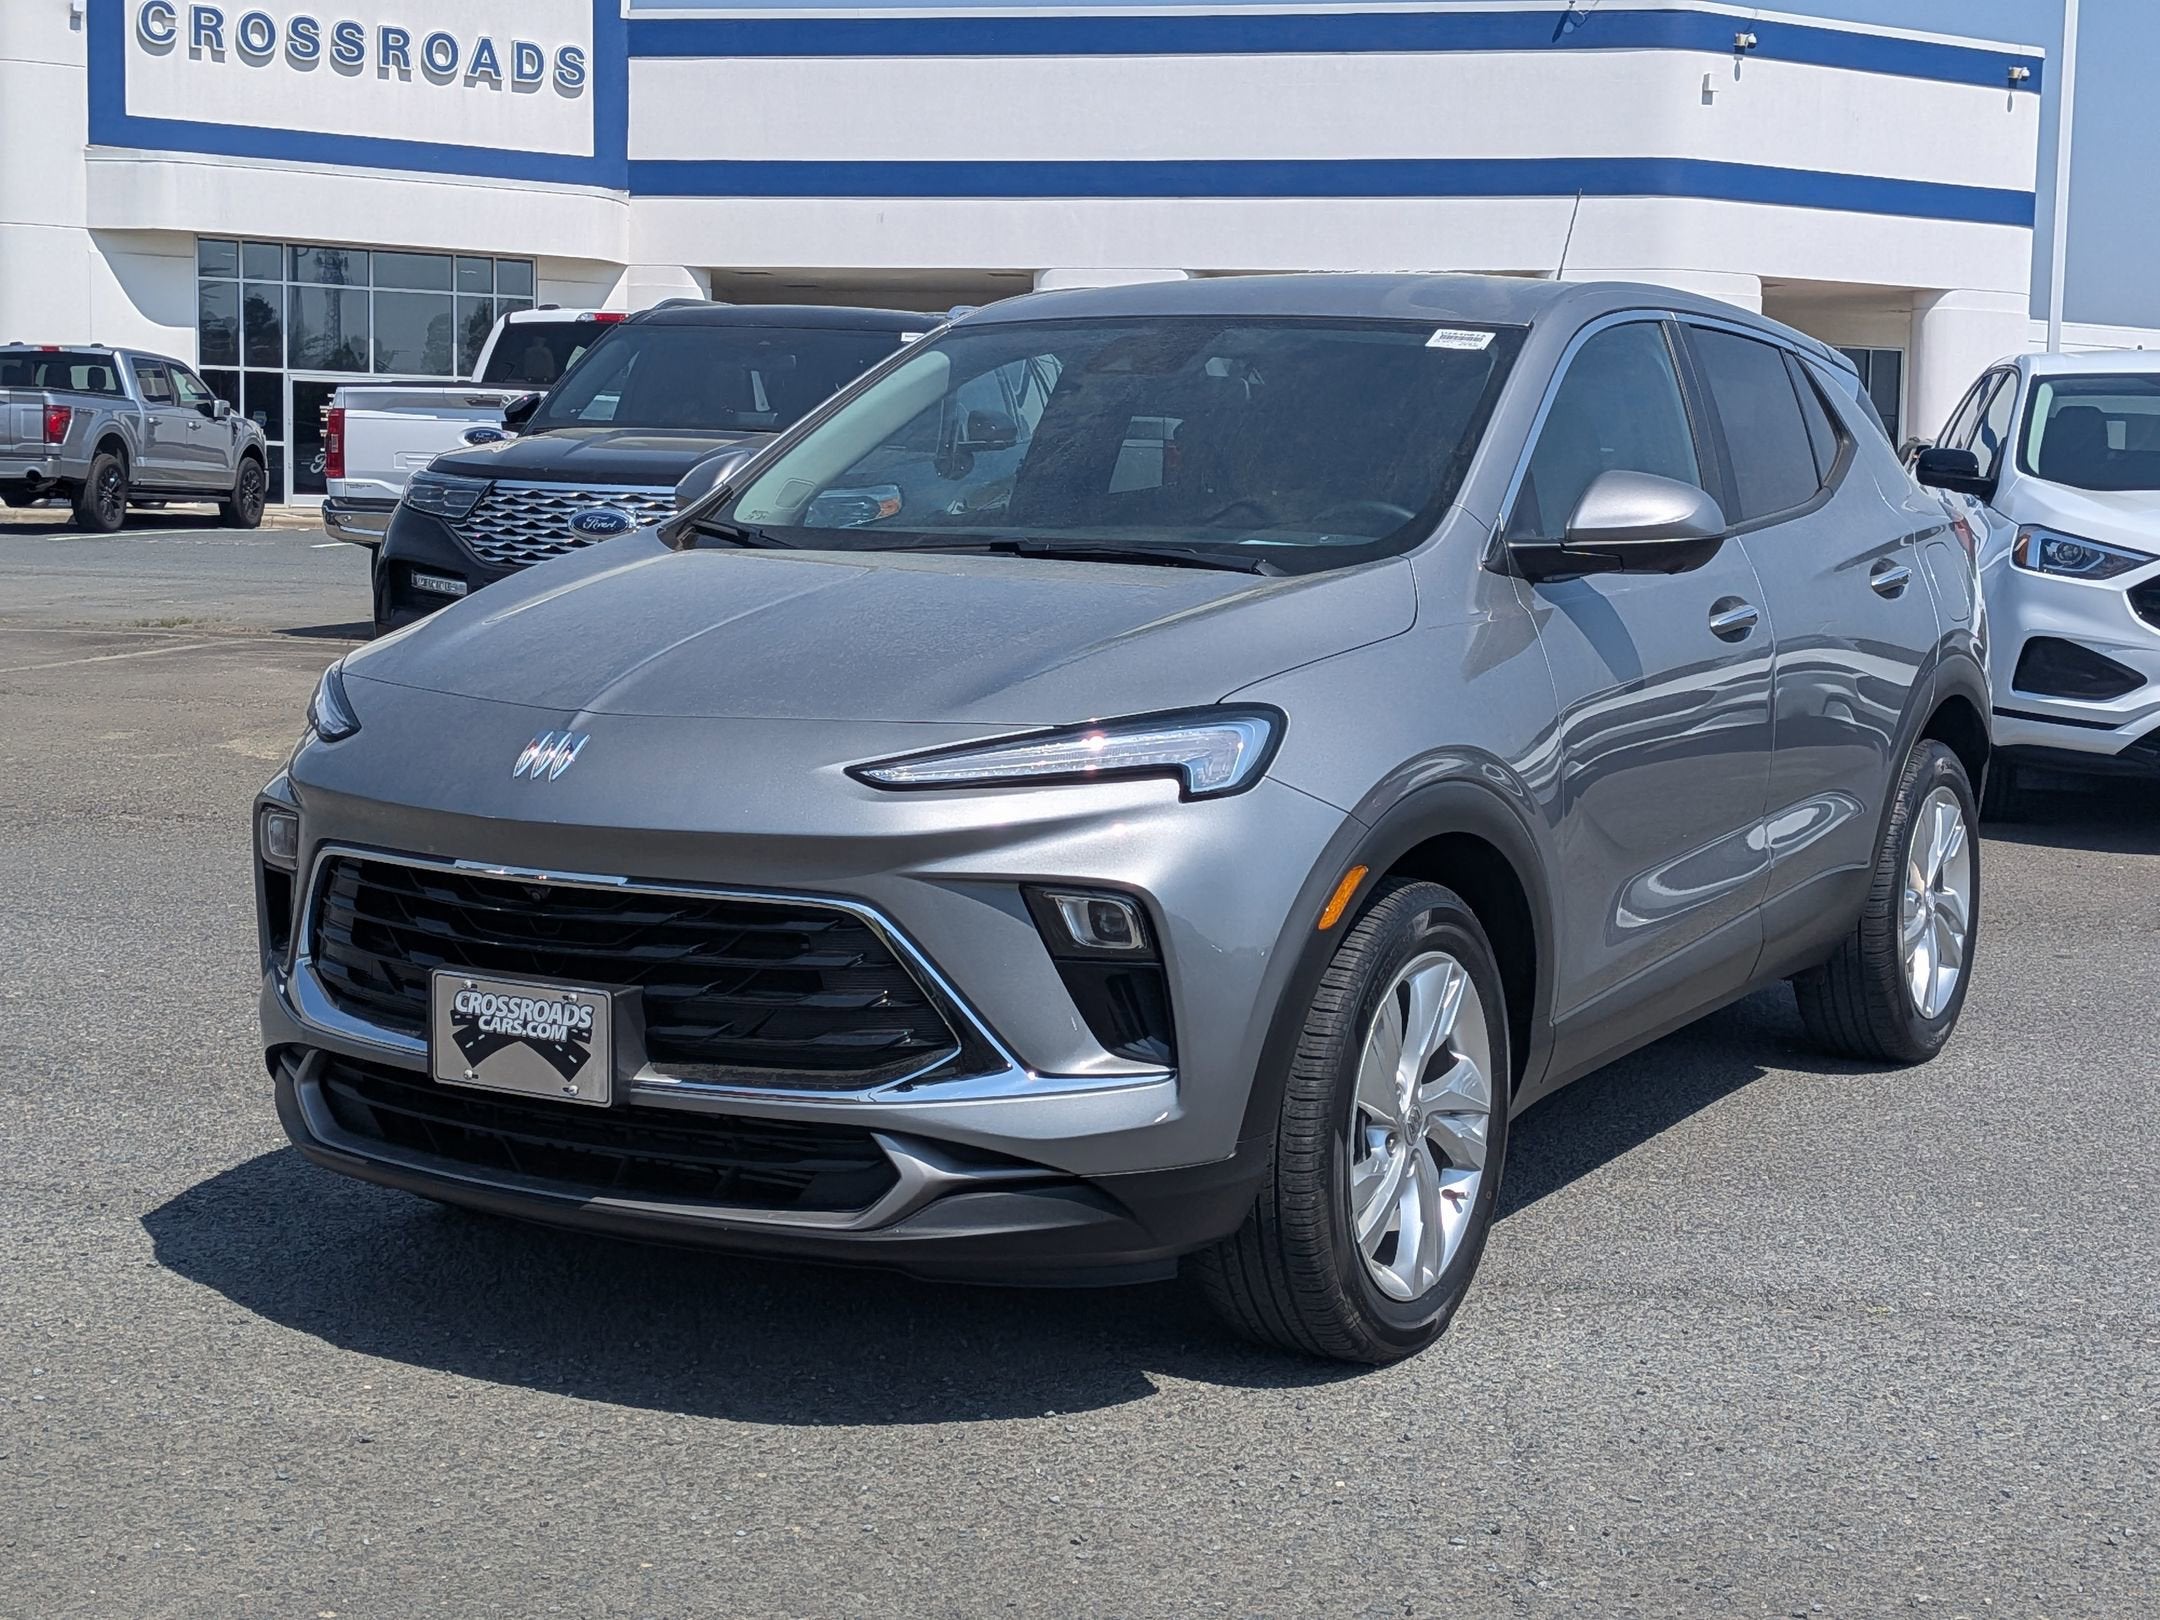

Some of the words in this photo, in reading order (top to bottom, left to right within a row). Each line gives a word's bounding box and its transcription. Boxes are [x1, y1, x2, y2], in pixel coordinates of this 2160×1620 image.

[138, 0, 588, 89] CROSSROADS
[582, 515, 617, 530] Ford
[454, 989, 594, 1029] CROSSROADS
[477, 1015, 568, 1042] CARS.COM
